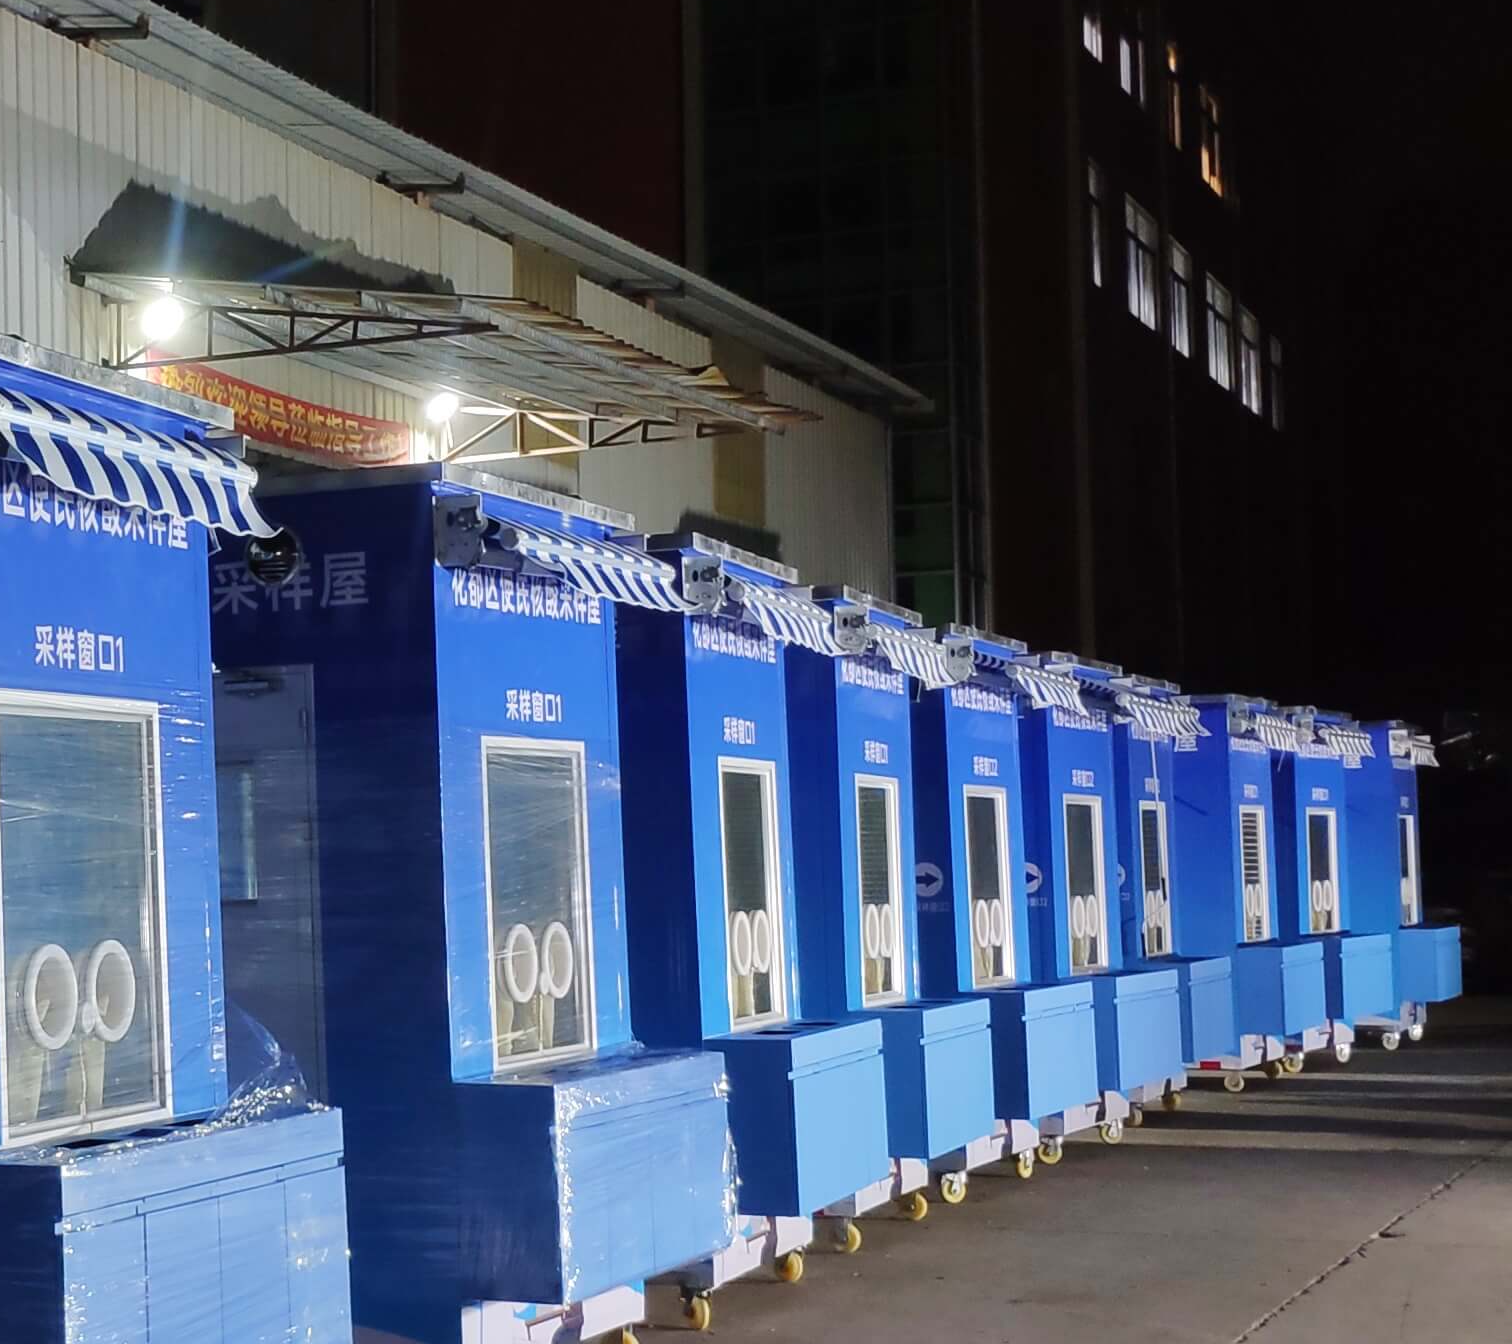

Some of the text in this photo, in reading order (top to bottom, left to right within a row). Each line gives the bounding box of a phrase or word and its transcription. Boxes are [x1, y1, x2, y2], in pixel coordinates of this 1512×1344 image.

[35, 624, 125, 673] 采样窗口1
[505, 689, 562, 723] 采样窗口1
